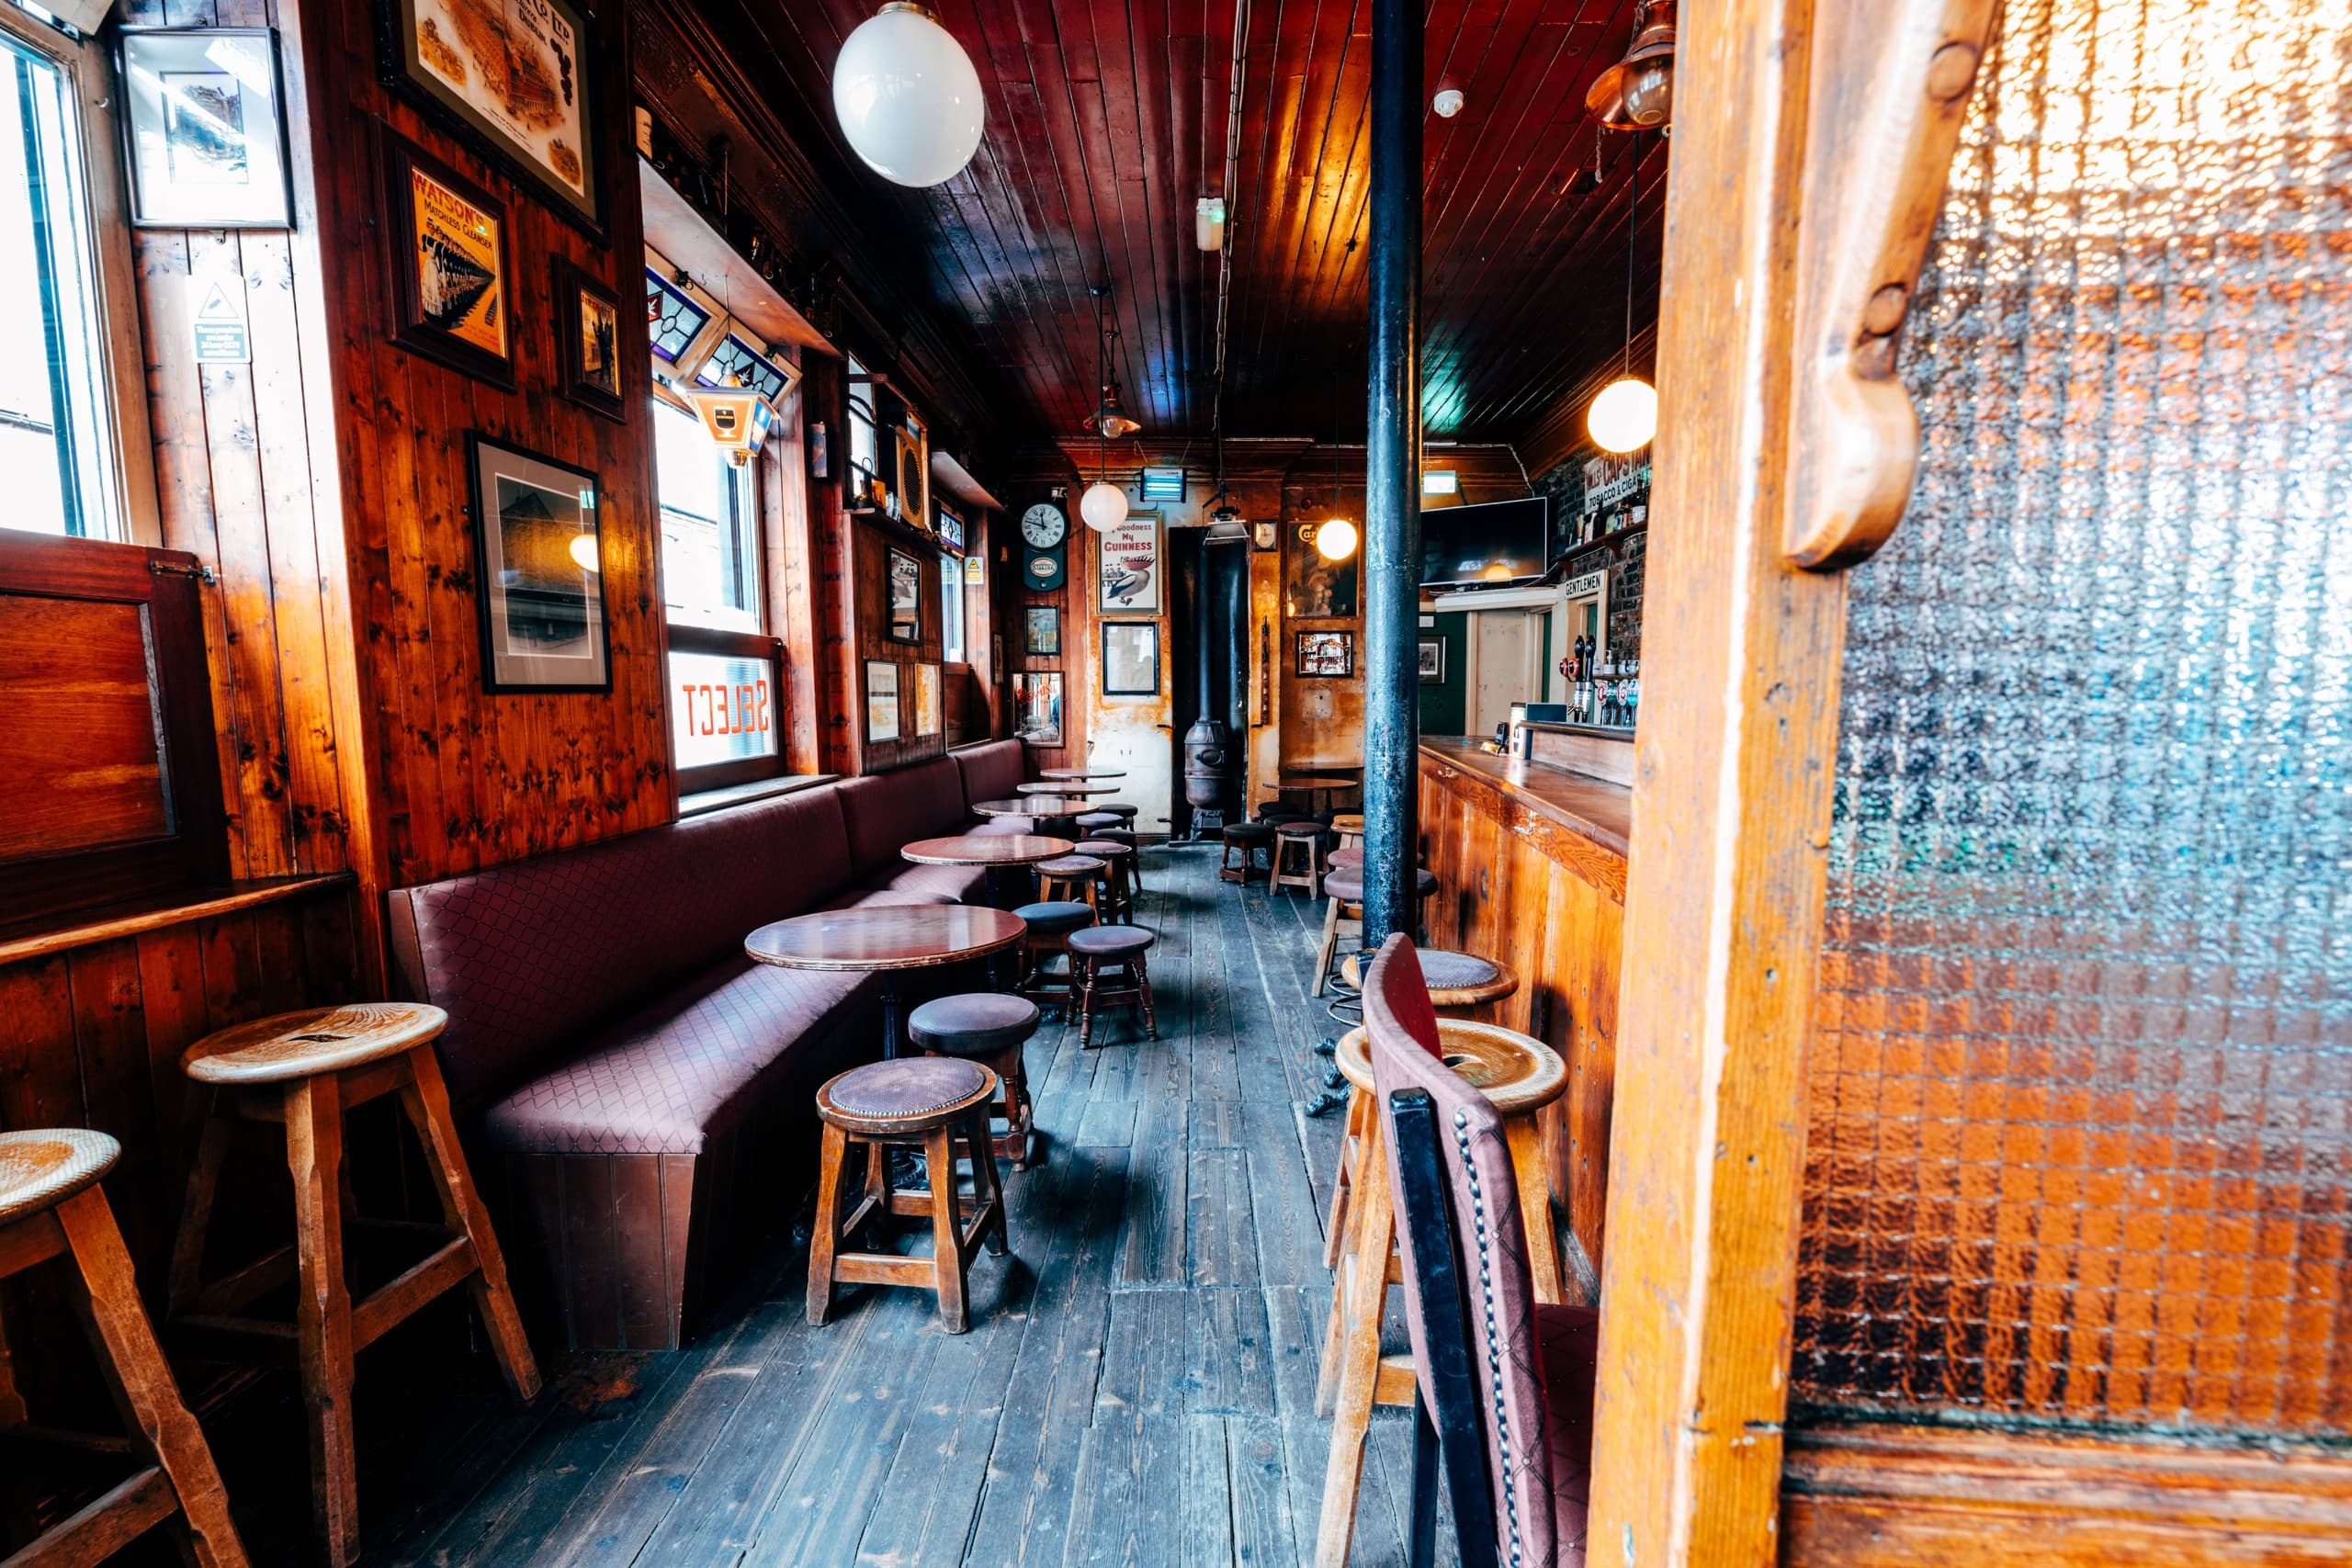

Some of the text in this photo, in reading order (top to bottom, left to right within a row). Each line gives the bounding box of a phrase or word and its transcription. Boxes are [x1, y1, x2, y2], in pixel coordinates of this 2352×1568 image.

[424, 198, 461, 231] MATCHLESS
[462, 223, 492, 251] CLEANSER
[1104, 542, 1152, 552] GUINNESS
[1122, 533, 1134, 542] My
[1566, 574, 1601, 595] GENTLEMEN
